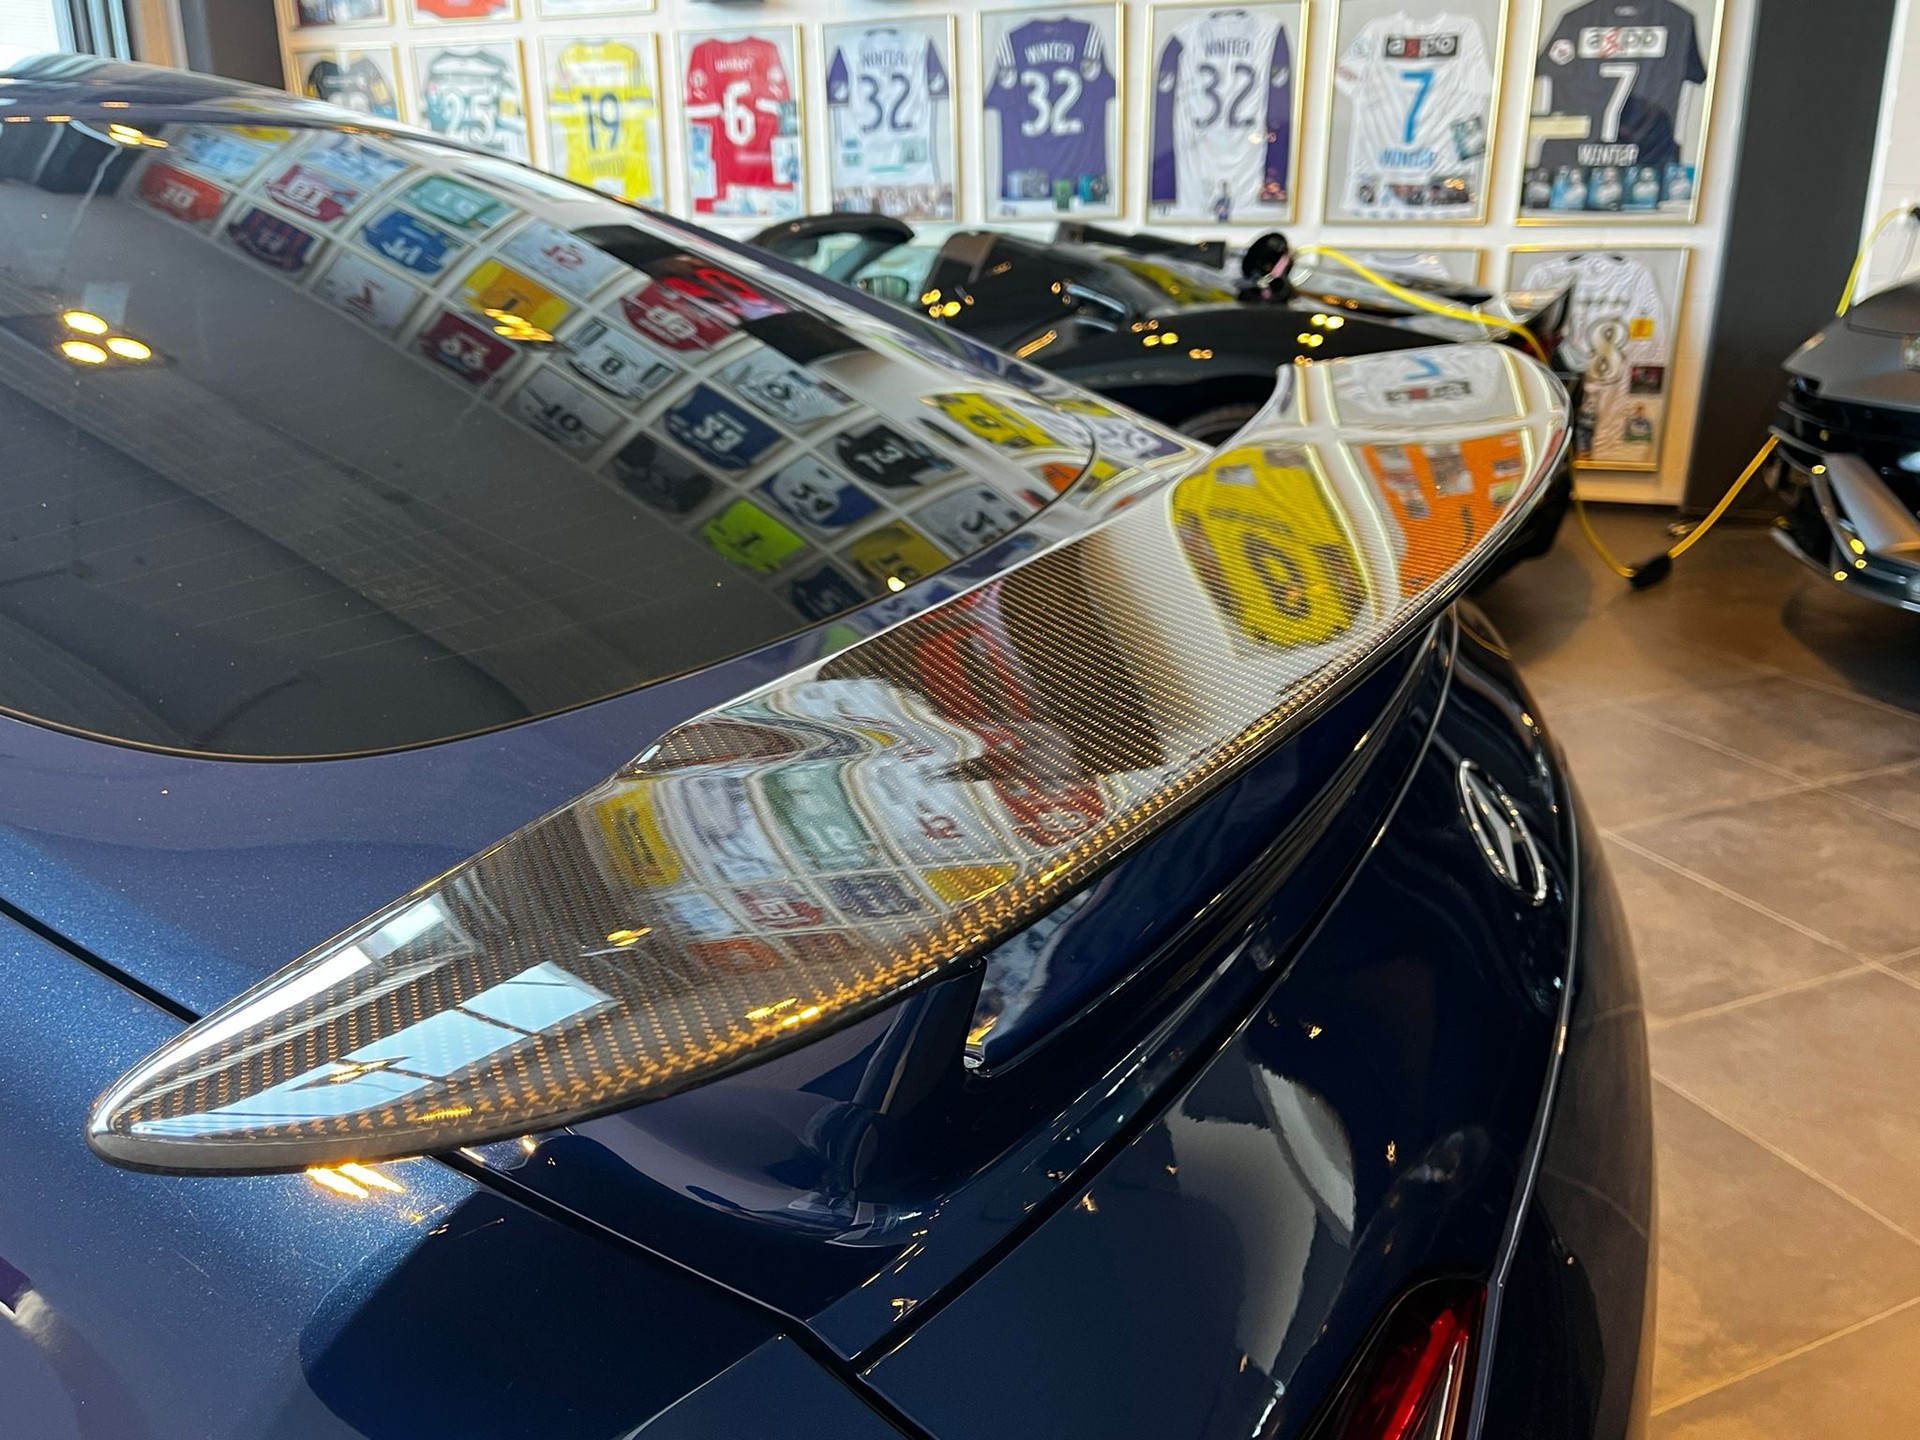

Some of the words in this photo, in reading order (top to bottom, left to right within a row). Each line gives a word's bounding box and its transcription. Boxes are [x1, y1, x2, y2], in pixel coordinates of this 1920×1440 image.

[1024, 42, 1075, 65] WINTER
[441, 90, 495, 145] 25
[581, 91, 620, 151] 19
[723, 79, 756, 148] 6
[860, 73, 912, 133] 32
[1020, 67, 1084, 136] 32
[1195, 63, 1256, 128] 32
[1401, 68, 1435, 145] 7
[1598, 62, 1641, 143] 7
[1577, 143, 1640, 167] WINTER
[1589, 317, 1627, 385] 8
